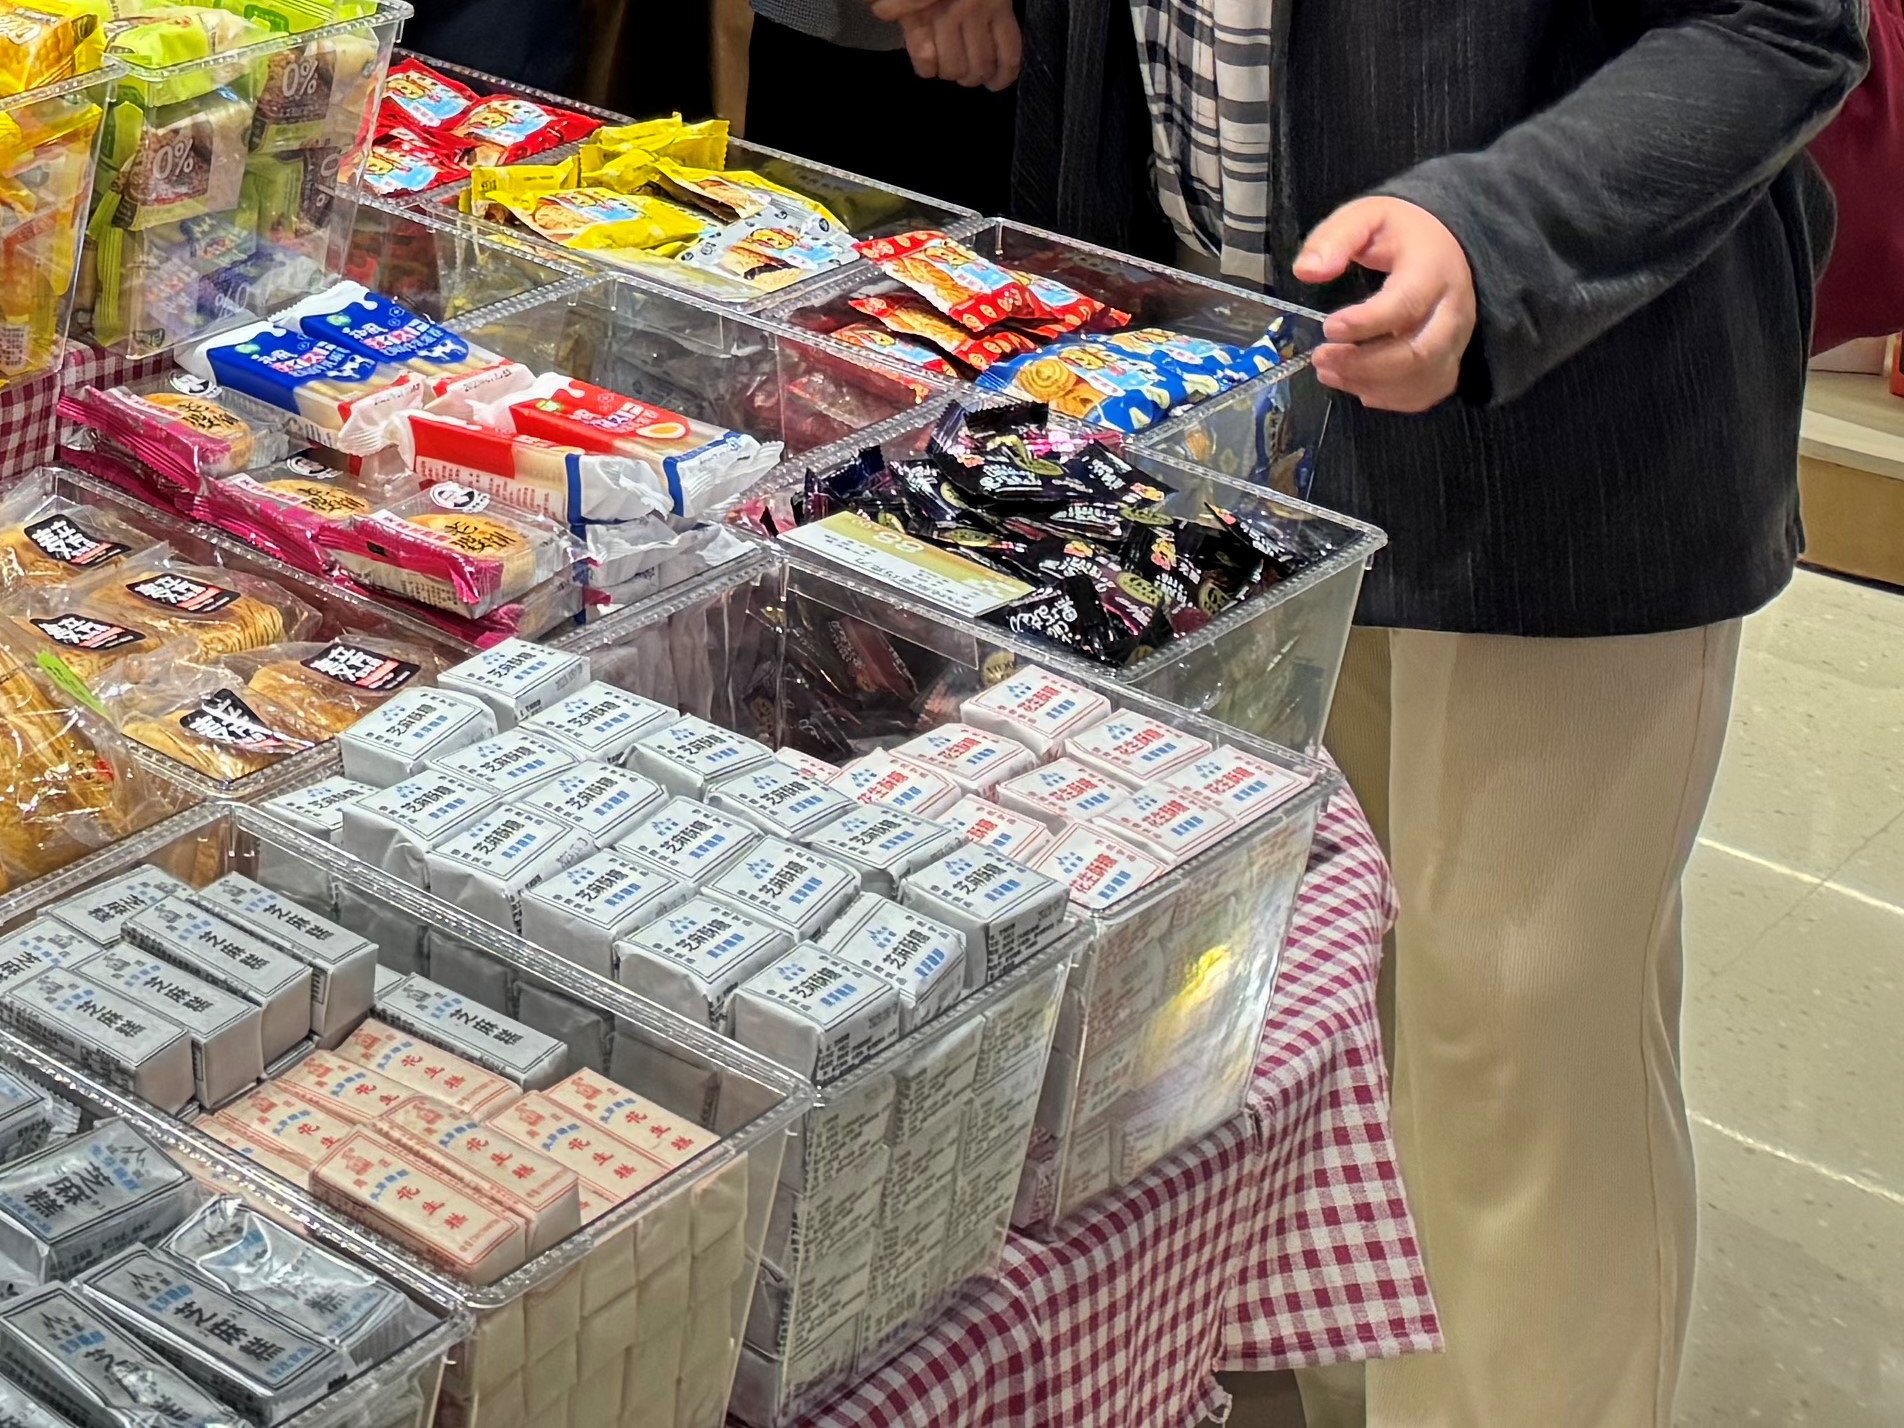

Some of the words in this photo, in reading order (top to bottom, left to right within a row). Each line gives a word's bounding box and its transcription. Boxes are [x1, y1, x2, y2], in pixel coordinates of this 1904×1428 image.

[281, 59, 319, 99] 0%
[150, 139, 195, 179] 0%
[262, 900, 336, 944] 芝麻糕
[197, 928, 270, 972] 芝麻糕
[142, 972, 211, 1012] 芝麻糕
[75, 998, 144, 1041] 芝麻糕
[449, 1008, 526, 1047] 芝麻糕
[399, 1051, 468, 1091] 花生糕
[624, 1108, 696, 1153] 花生糕
[466, 1133, 535, 1182] 花生糕
[568, 1133, 639, 1182] 花生糕
[396, 1180, 468, 1232] 花生糕
